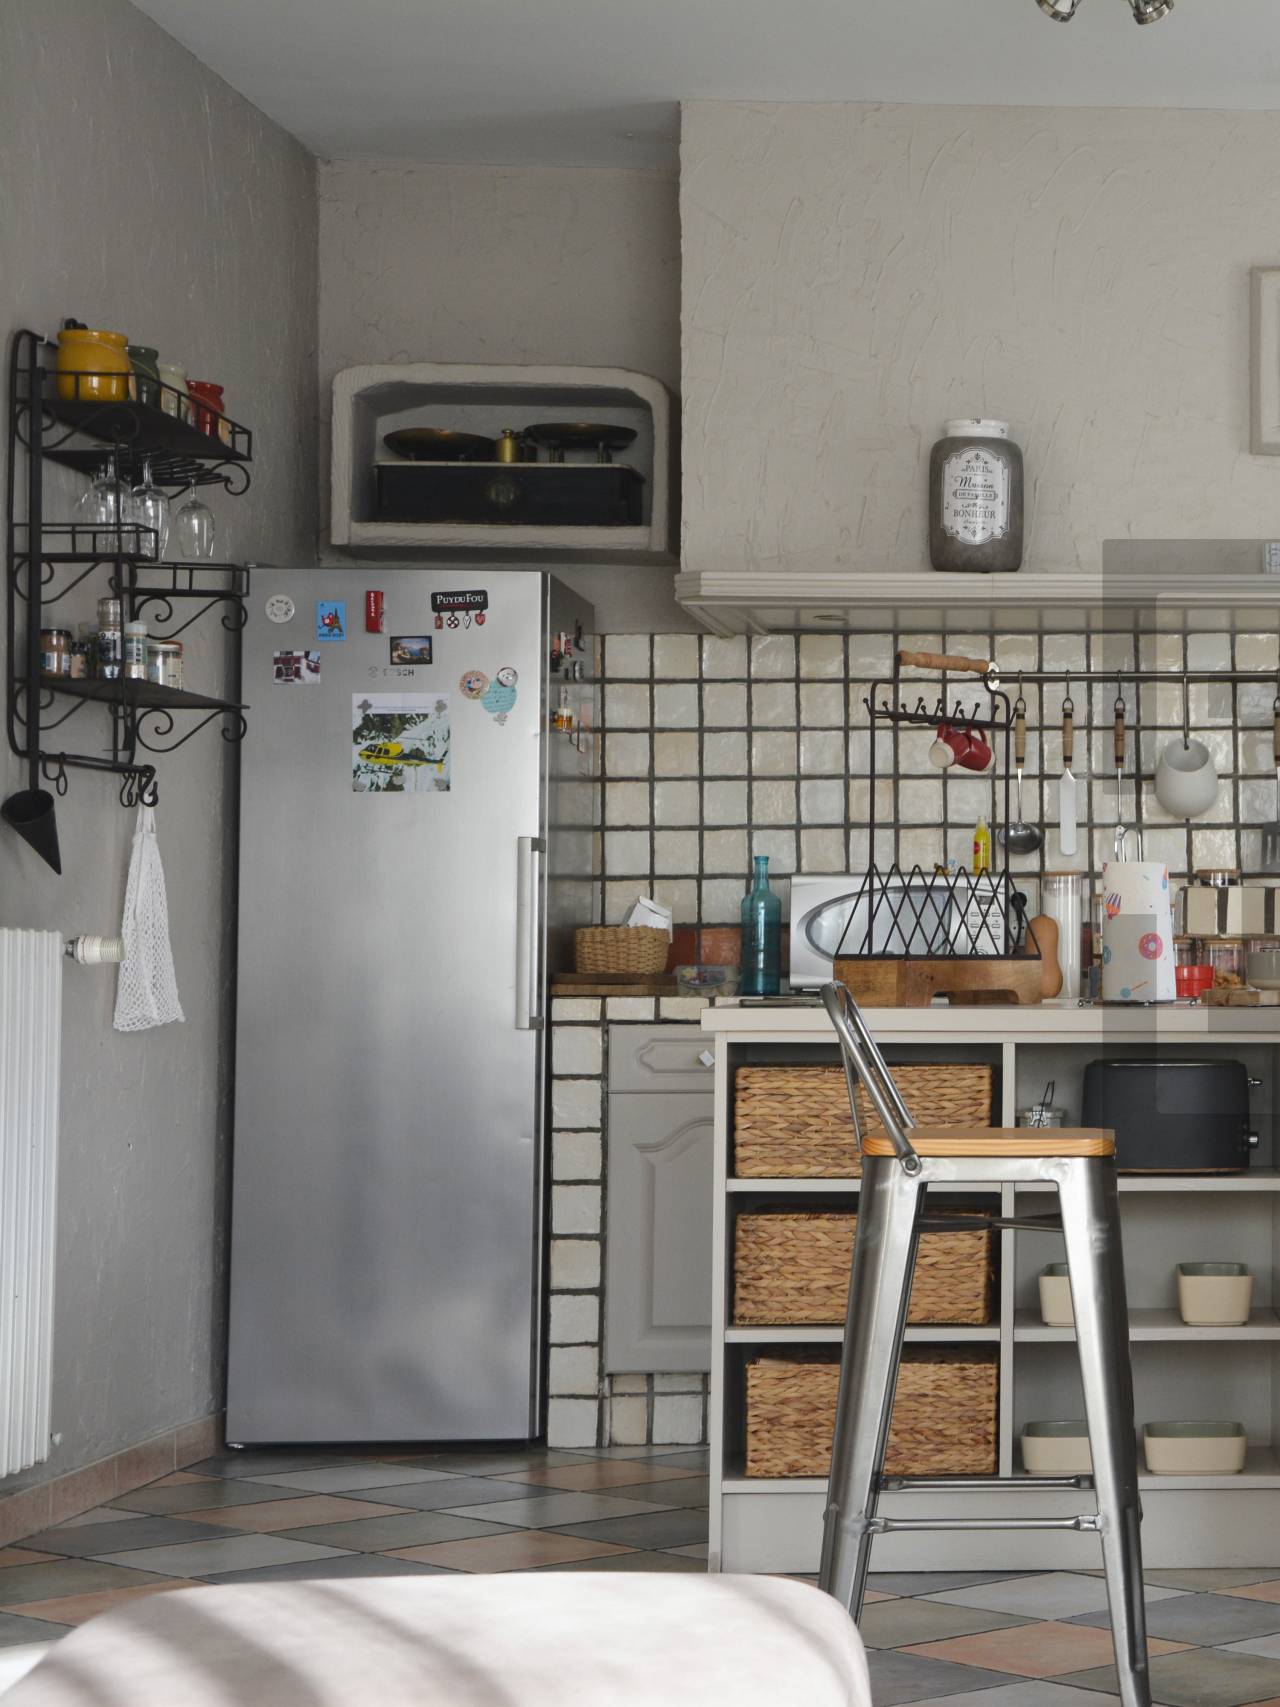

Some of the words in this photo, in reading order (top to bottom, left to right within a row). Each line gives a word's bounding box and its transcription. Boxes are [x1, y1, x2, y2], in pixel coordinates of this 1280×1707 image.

[965, 465, 989, 473] PARIS
[953, 509, 996, 519] BONHEUR
[383, 668, 415, 677] BSCH
